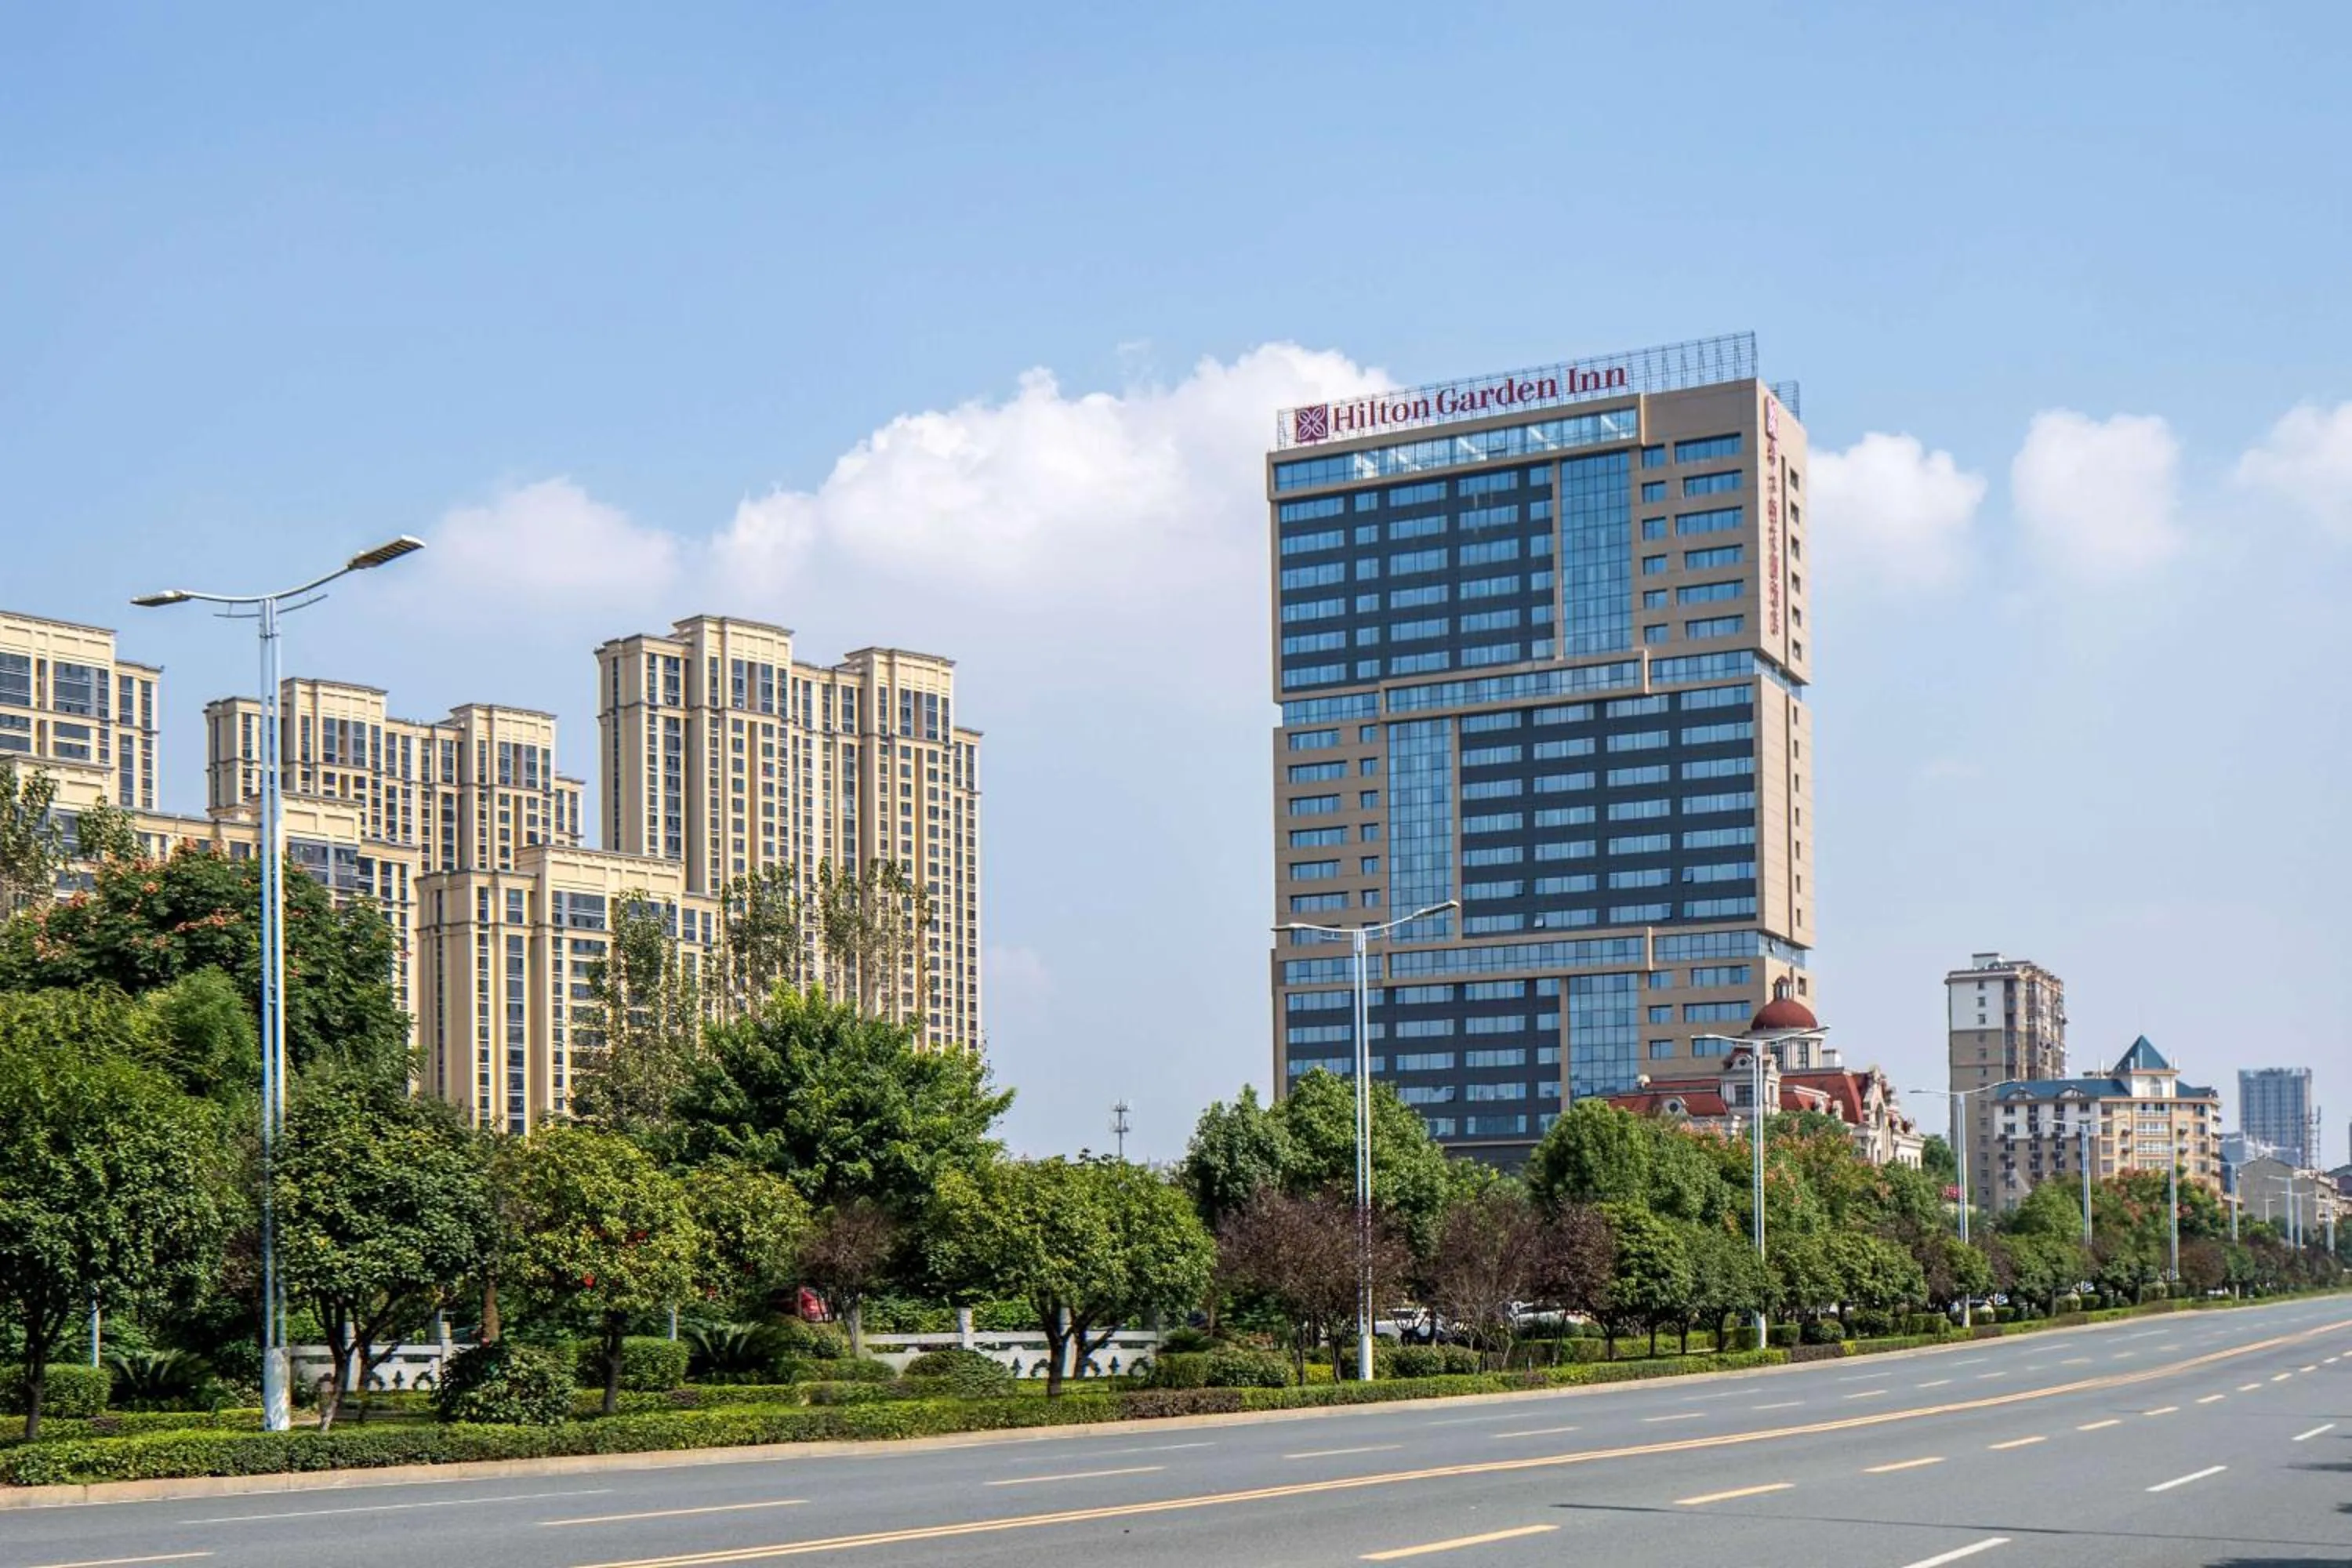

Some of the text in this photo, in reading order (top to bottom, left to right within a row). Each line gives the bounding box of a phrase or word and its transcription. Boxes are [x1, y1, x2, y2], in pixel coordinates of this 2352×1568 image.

[1334, 366, 1628, 431] Hilton Garden Inn
